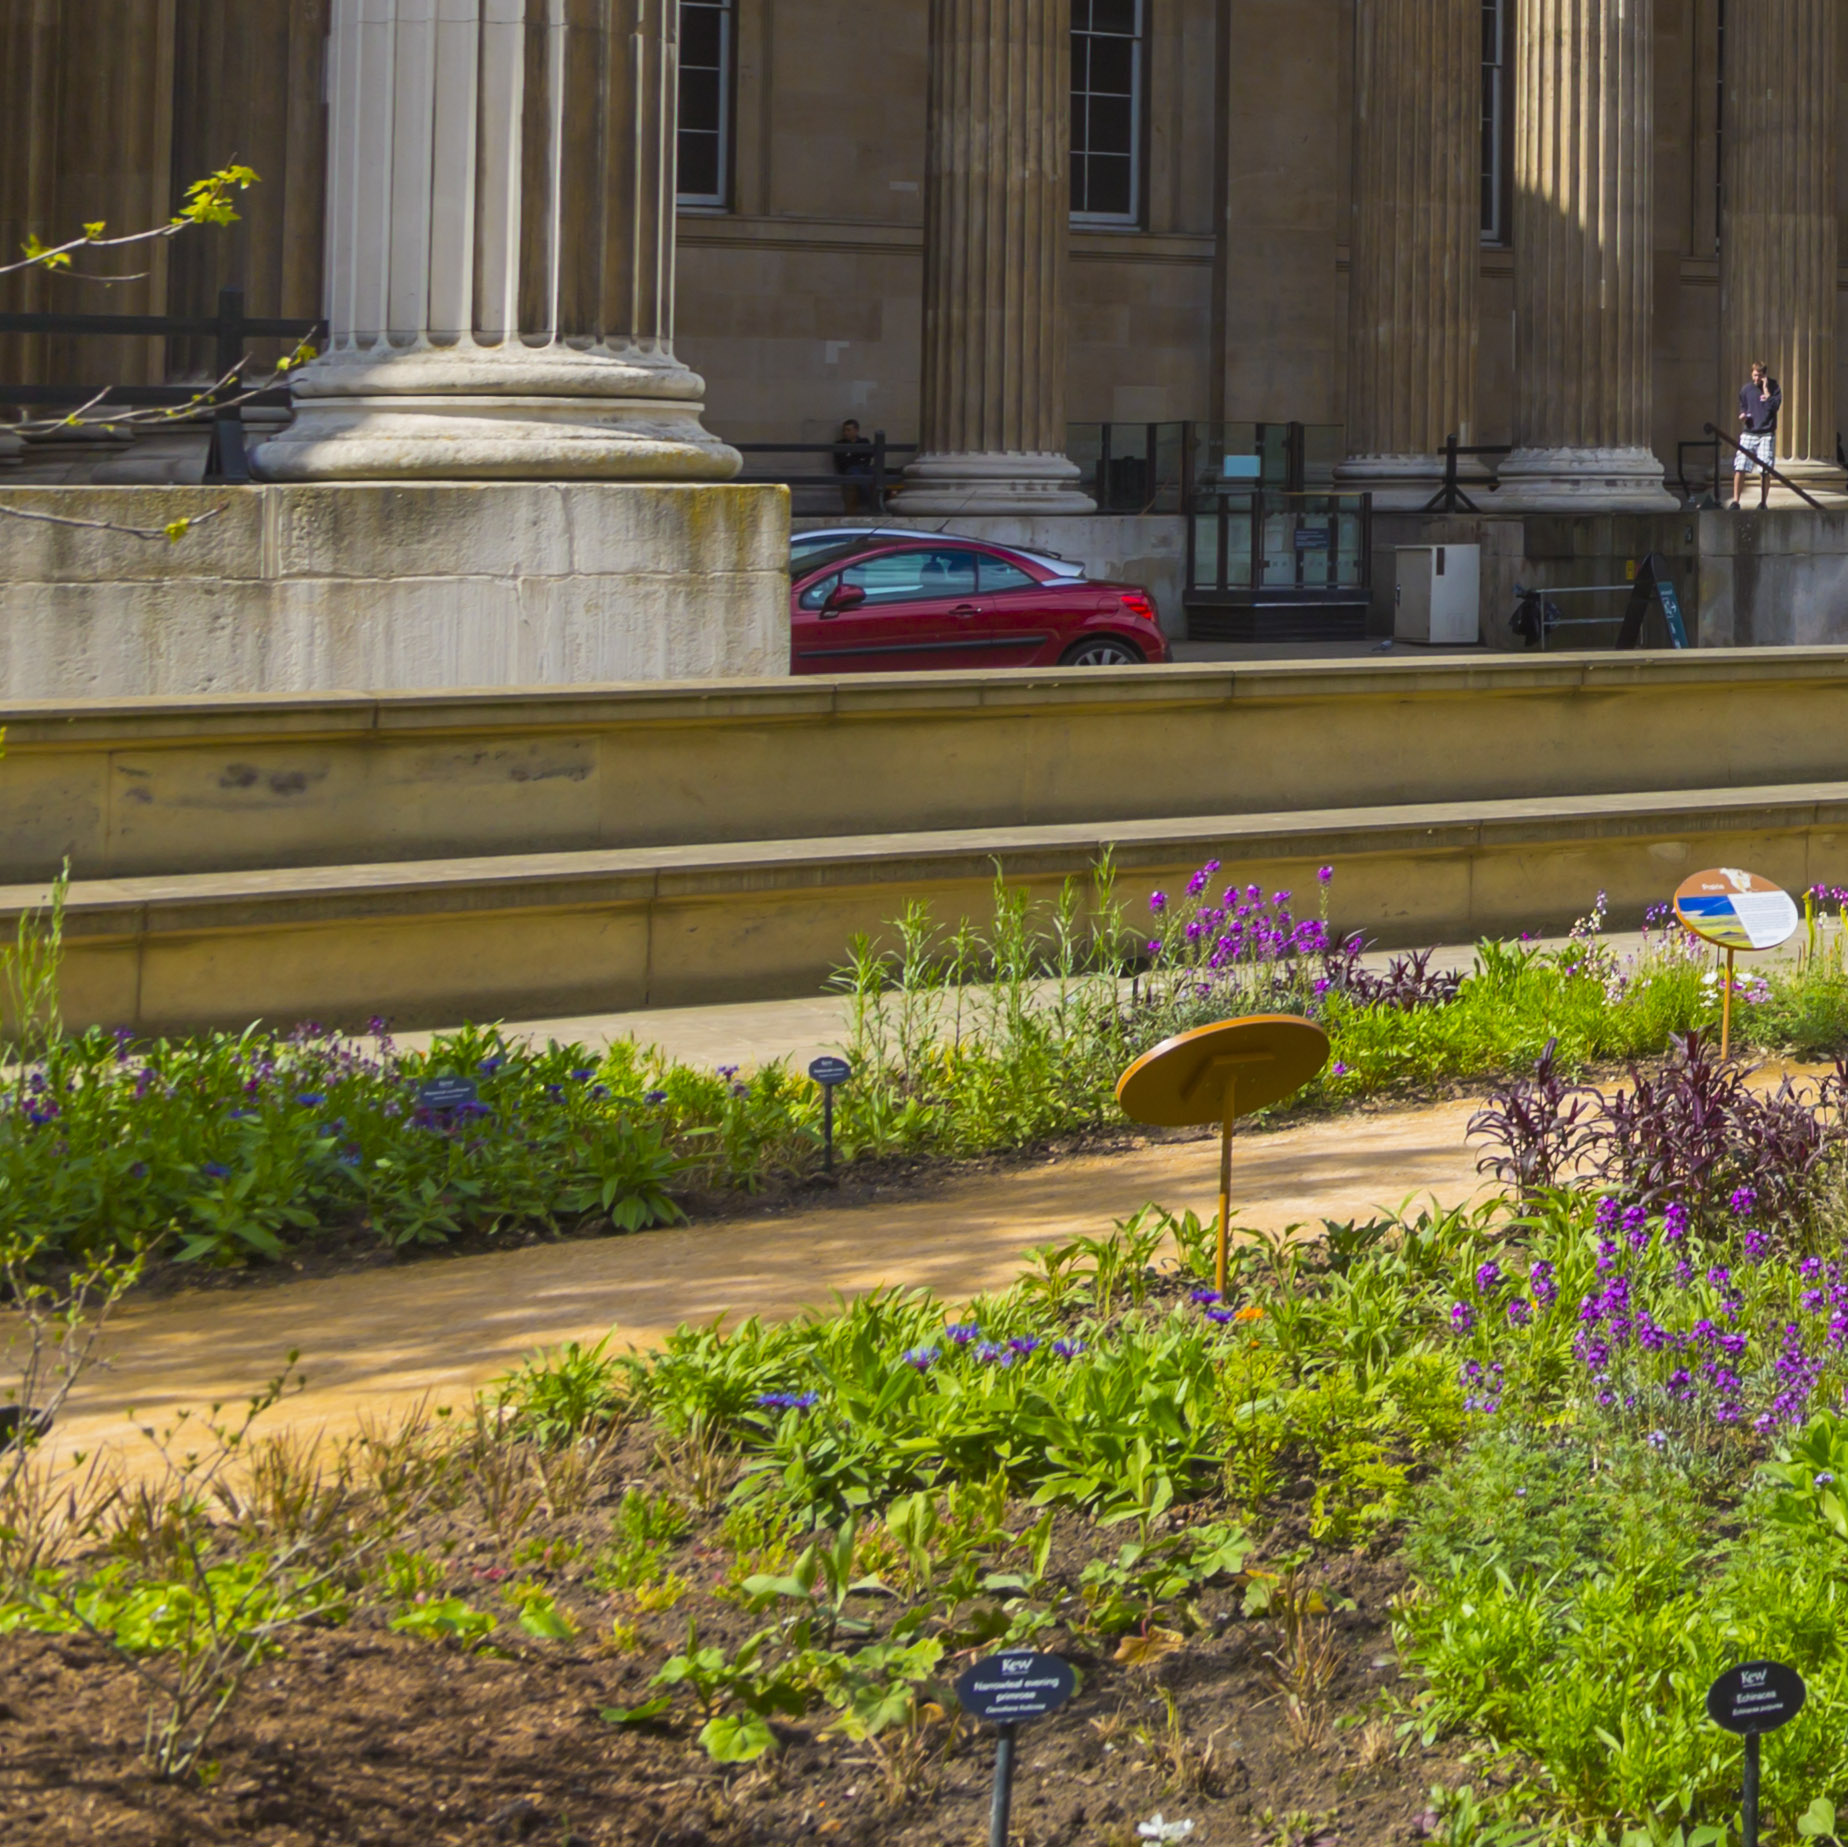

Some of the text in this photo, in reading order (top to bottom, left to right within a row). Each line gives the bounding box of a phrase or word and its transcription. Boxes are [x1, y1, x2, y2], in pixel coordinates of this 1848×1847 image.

[1002, 1657, 1034, 1672] Kew
[1741, 1668, 1767, 1684] Kew
[1737, 1691, 1777, 1704] Echinacea
